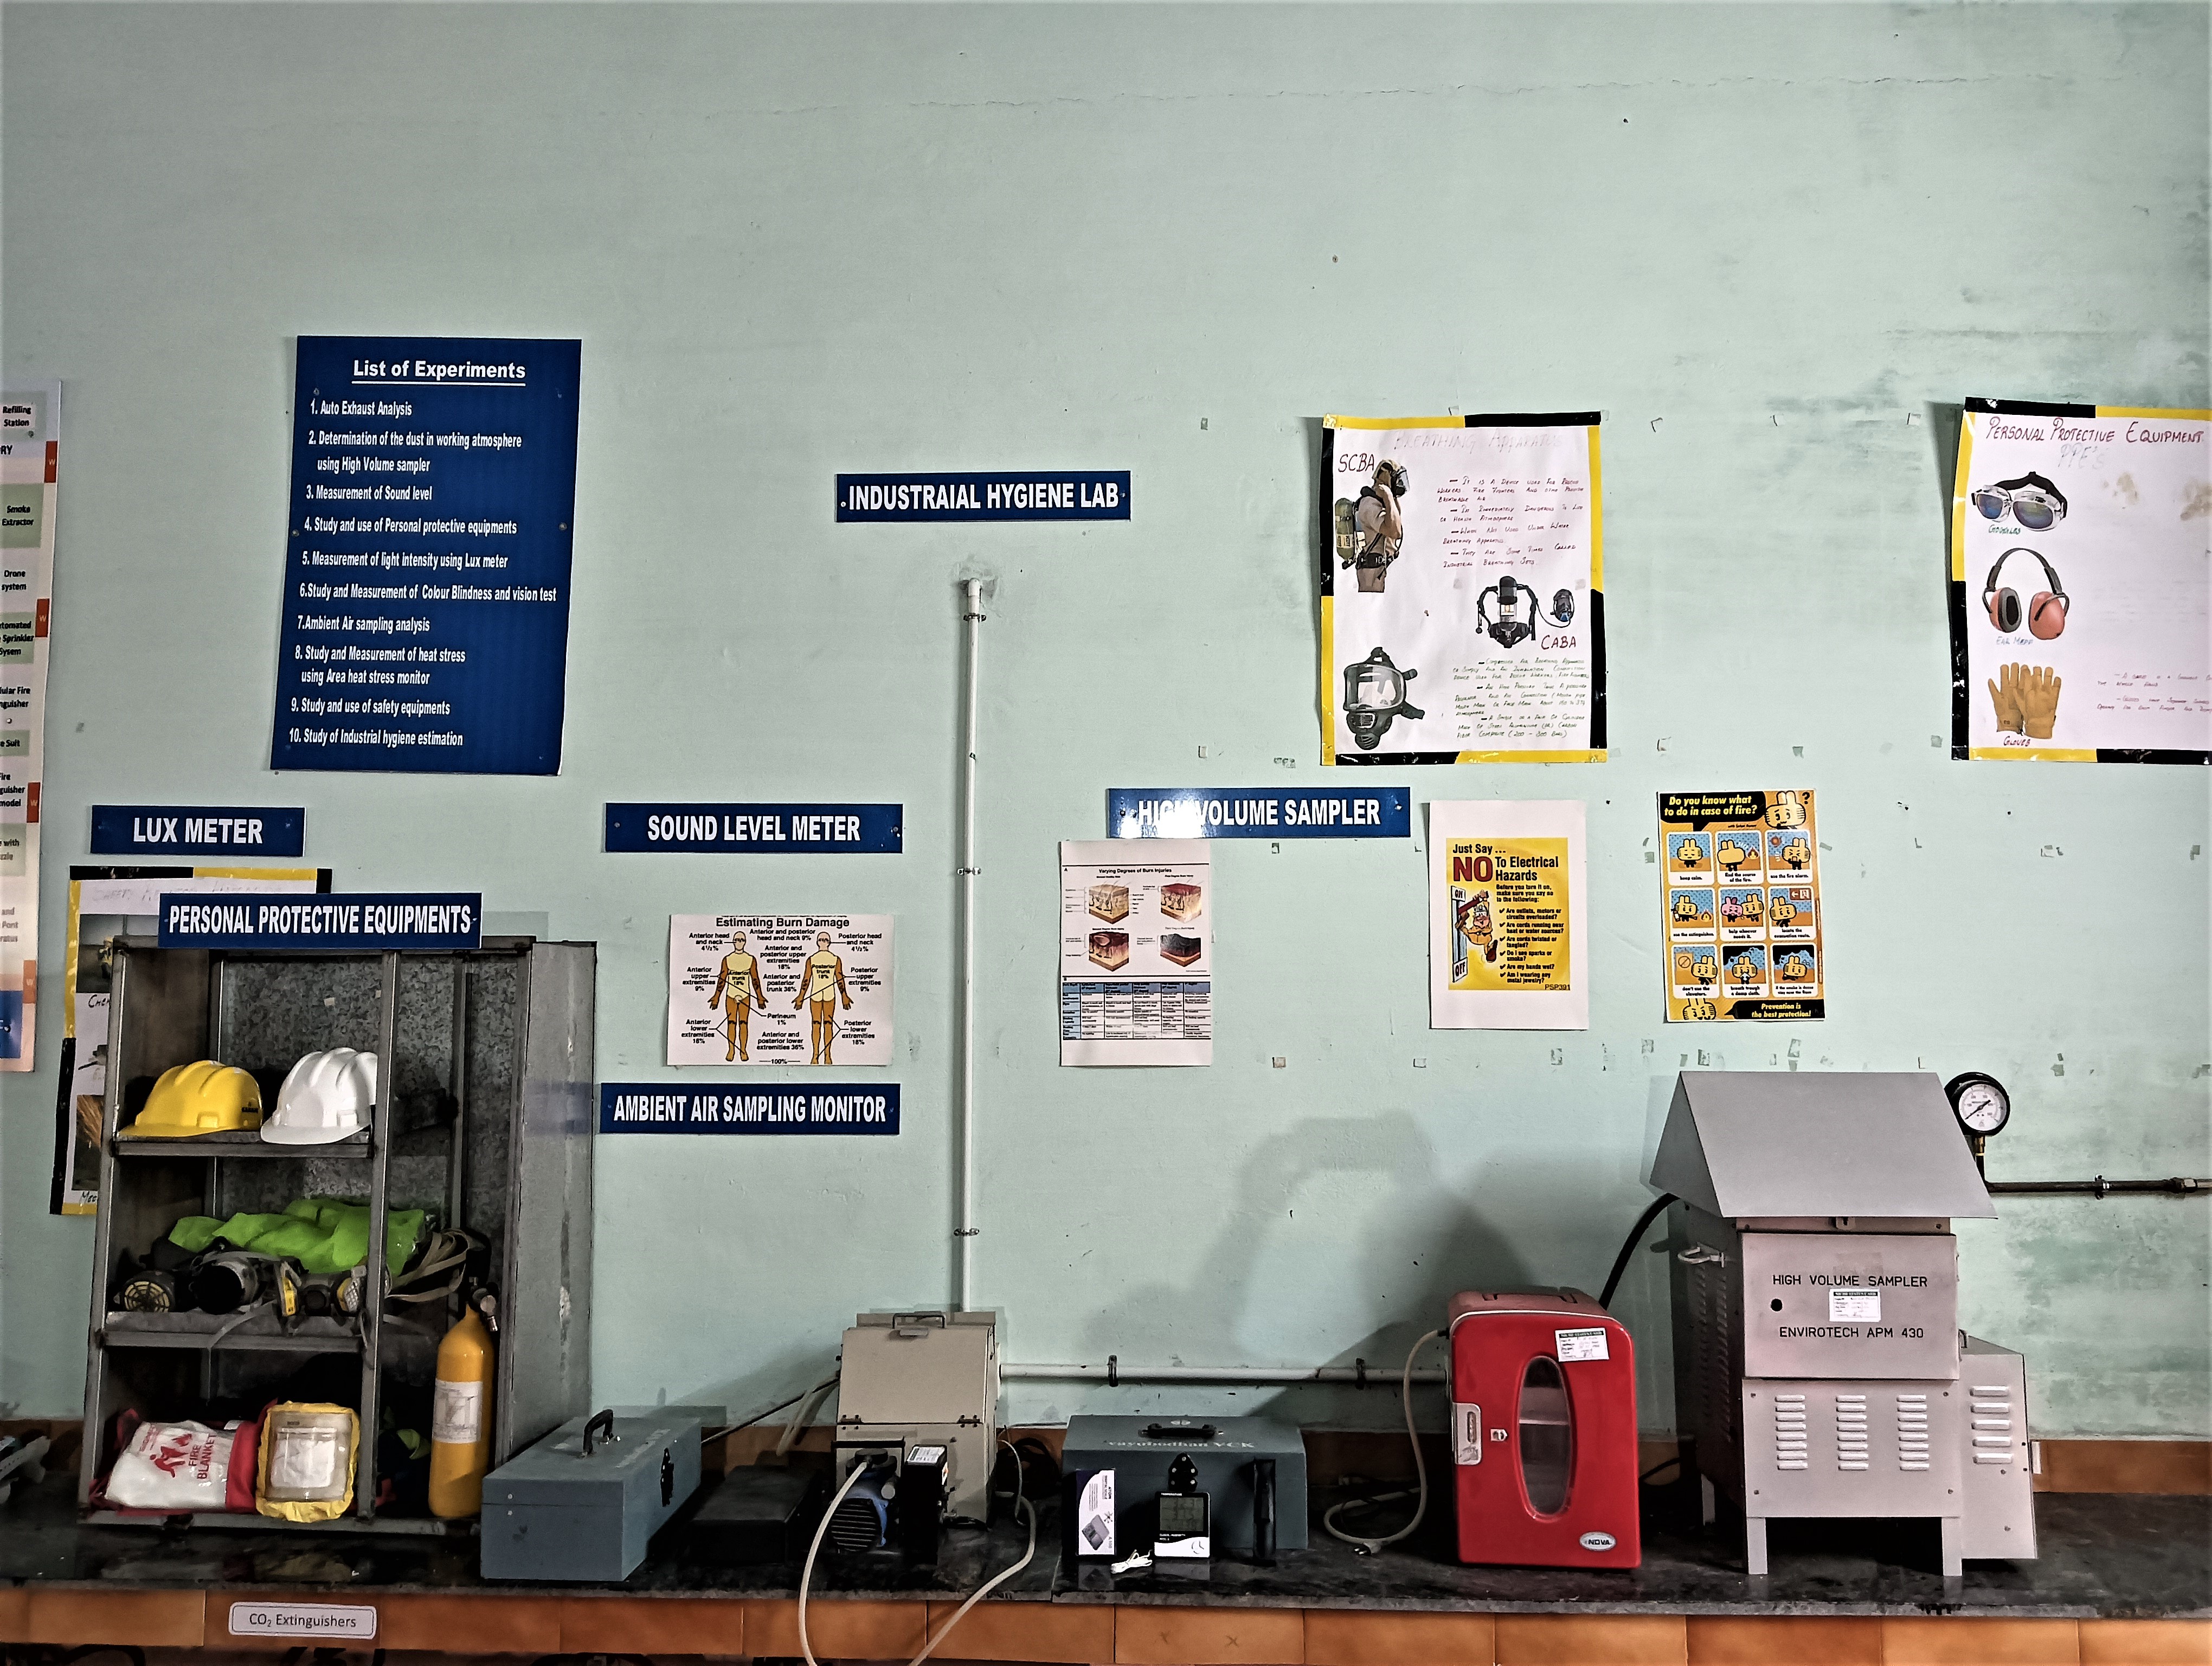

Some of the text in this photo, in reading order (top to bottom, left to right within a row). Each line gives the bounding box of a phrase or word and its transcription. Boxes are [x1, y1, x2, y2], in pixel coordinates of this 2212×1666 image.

[354, 360, 525, 381] List of Experiments
[3, 406, 31, 414] Refilling
[311, 399, 411, 419] 1. Auto Exhaust Analysis
[1986, 416, 2204, 443] PERSONAL PROTECTIVE EQUIPMENT
[308, 430, 522, 450] 2. Determination of the dust in working atmosphere
[318, 456, 430, 475] using High Volume sampler
[1338, 453, 1375, 472] SCBA
[306, 485, 432, 500] 3. Measurement of Sound level
[850, 483, 1118, 510] INDUSTRAIAL HYGIENE LAB
[303, 551, 508, 571] 5. Measurement of light intensity using Lux meter
[2, 584, 27, 592] system
[300, 583, 556, 601] 6.Study and Measurement of Colour Blindness and vision test
[298, 615, 430, 635] 7.Ambient Air sampling analysis
[3, 634, 34, 644] Sprinkler
[1541, 635, 1576, 650] CABA
[295, 645, 465, 663] 8. Study and Measurement of heat stress
[302, 669, 430, 686] using Area heat stress monitor
[290, 728, 462, 748] 10. Study of Industrial hygiene estimation
[1669, 795, 1752, 807] Do you know what
[1194, 800, 1278, 825] VOLUME
[1285, 799, 1380, 825] SAMPLER
[1676, 807, 1688, 816] do
[1690, 806, 1699, 815] in
[1724, 805, 1733, 815] of
[1735, 805, 1757, 814] fire?
[134, 818, 262, 843] LUX METER
[648, 816, 860, 841] SOUND LEVEL METER
[1453, 844, 1493, 855] Just Say
[1454, 856, 1493, 882] NO
[1495, 856, 1558, 867] To Electrical
[1496, 870, 1537, 881] Hazards
[170, 905, 470, 935] PERSONAL PROTECTIVE EQUIPMENTS
[716, 918, 849, 929] Estimating Burn Damage
[1456, 962, 1465, 976] OFF
[614, 1095, 885, 1122] AMBIENT AIR SAMPLING MONITOR
[1773, 1275, 1927, 1287] HIGH VOLUME SAMPLER
[1780, 1327, 1923, 1338] ENVIROTECH APM 430
[188, 1444, 202, 1466] FIRE
[197, 1435, 217, 1479] BLANKET
[276, 1614, 356, 1629] Extinguishers
